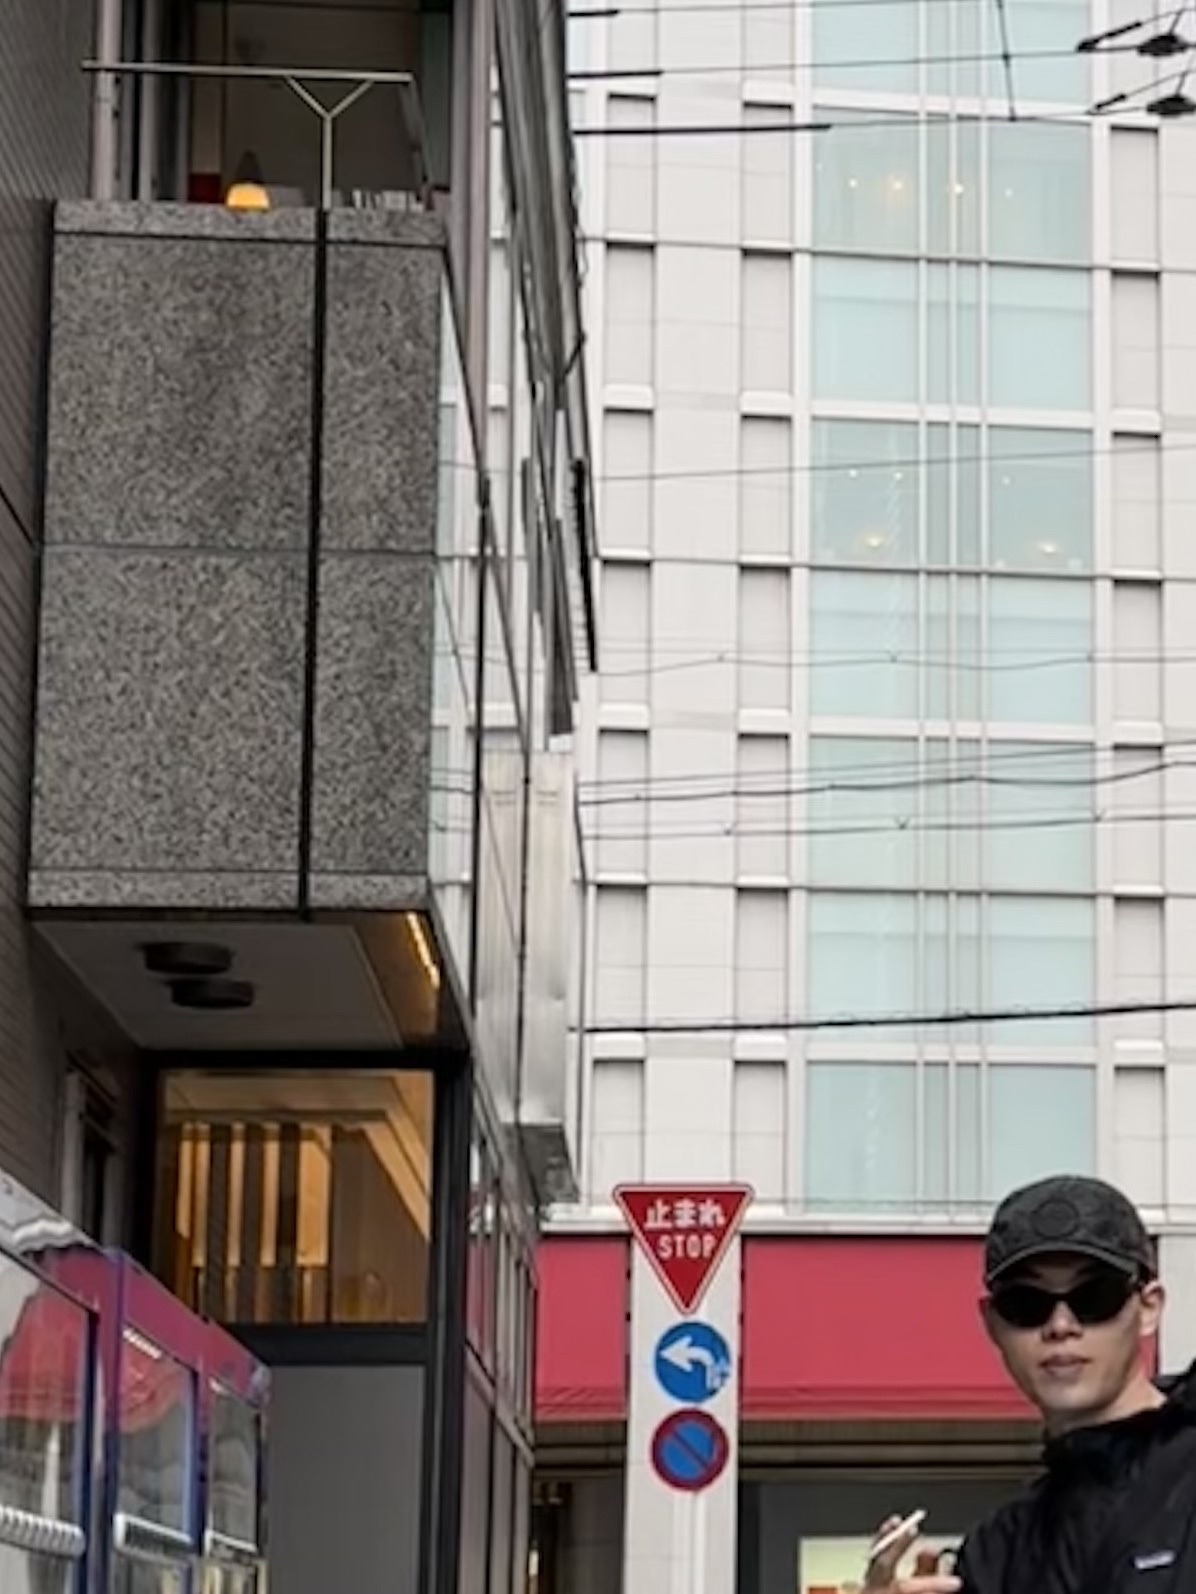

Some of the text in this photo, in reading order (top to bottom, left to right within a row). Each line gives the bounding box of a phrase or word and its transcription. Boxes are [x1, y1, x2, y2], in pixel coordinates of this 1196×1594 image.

[643, 1198, 726, 1230] 止まれ
[657, 1233, 716, 1259] STOP
